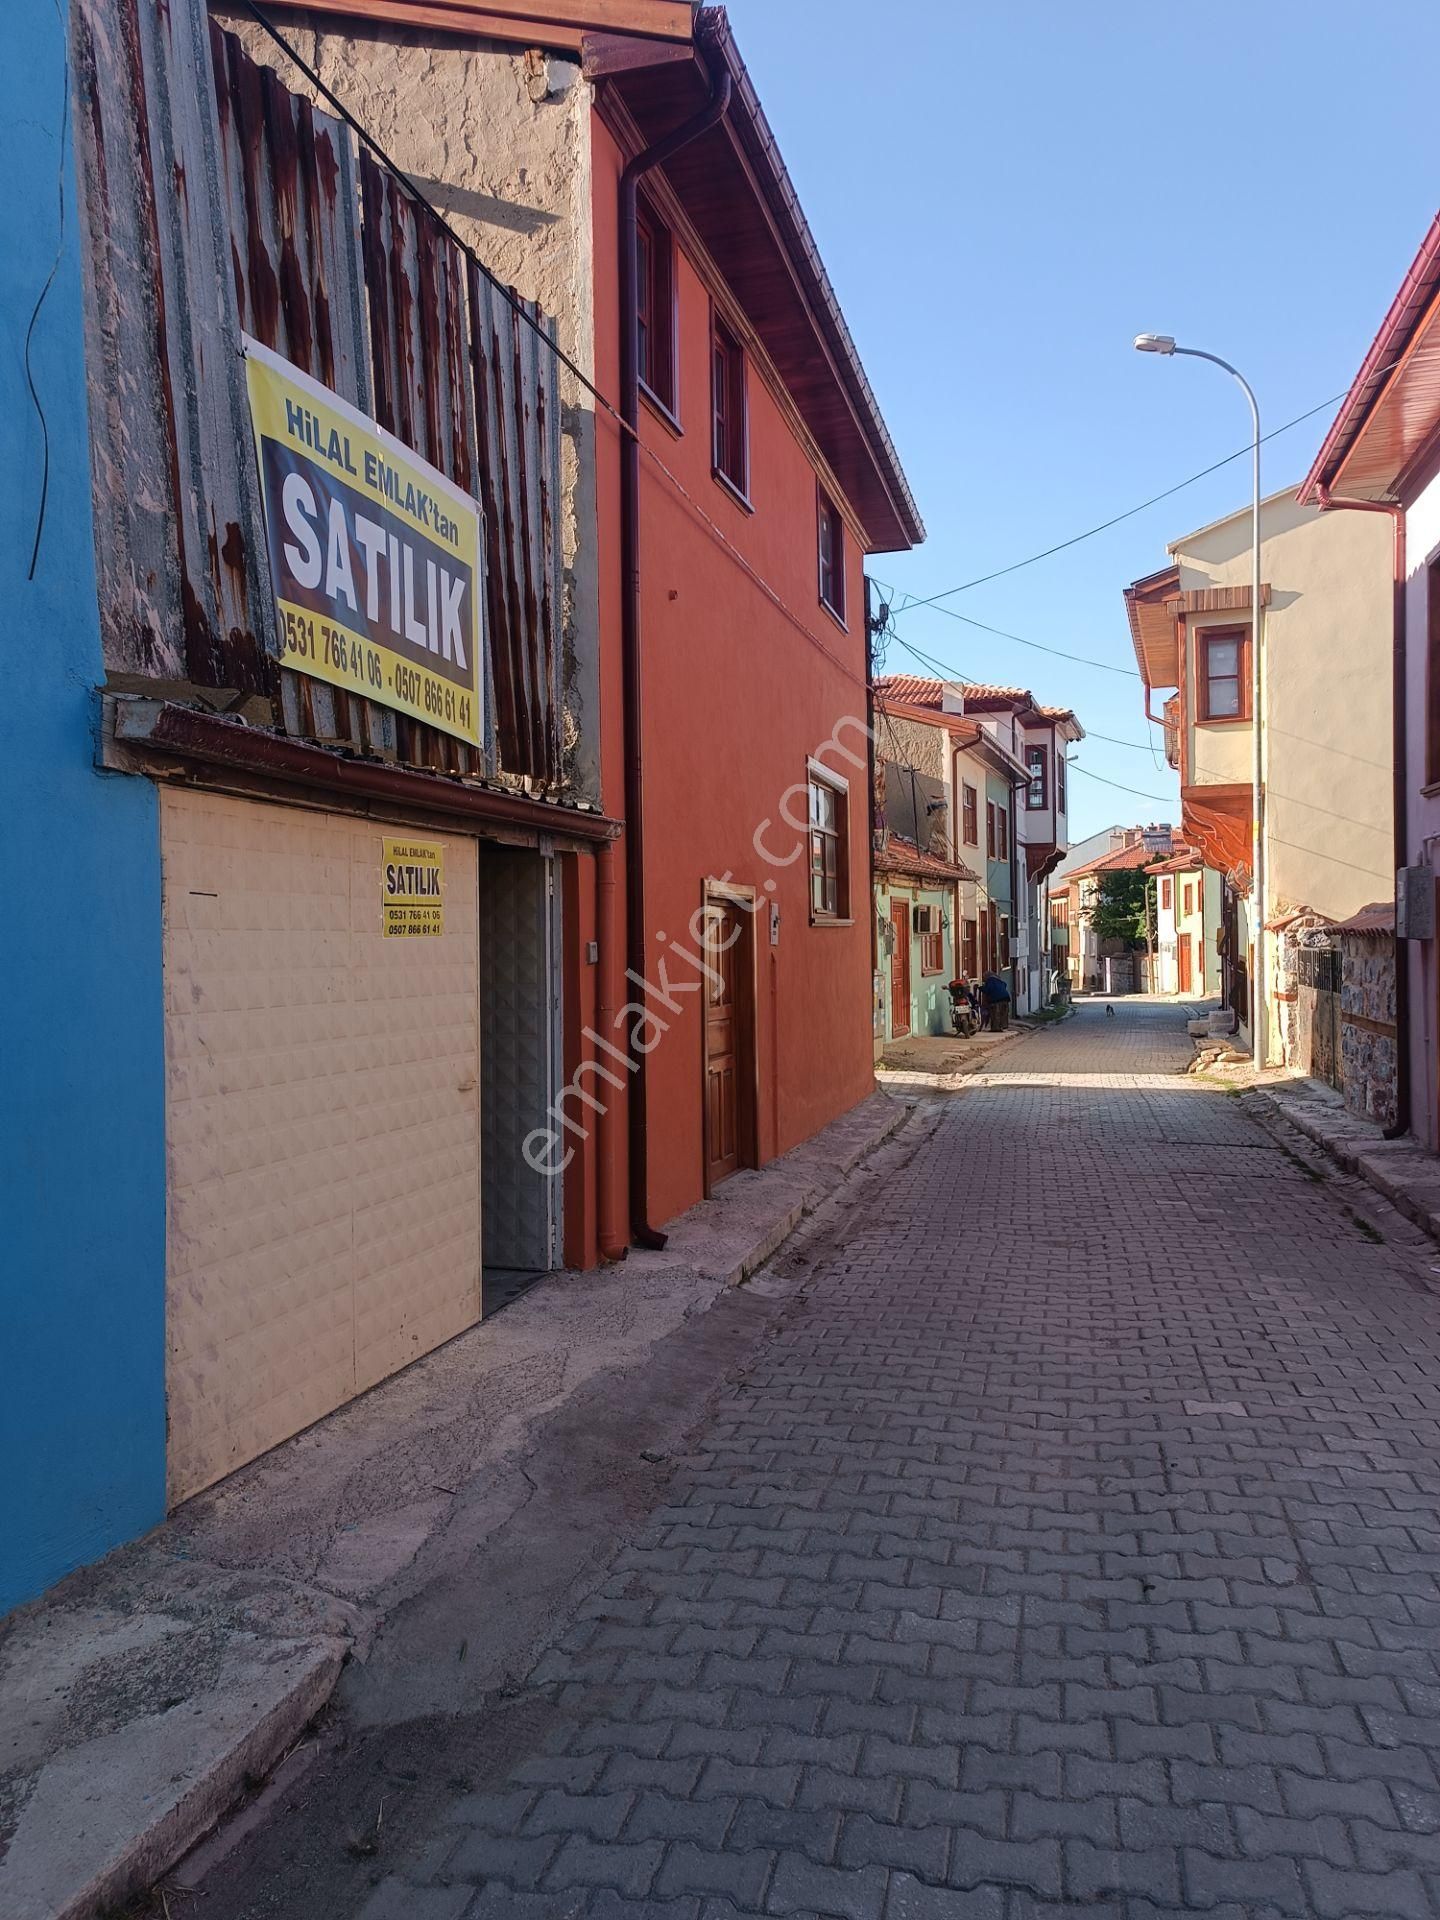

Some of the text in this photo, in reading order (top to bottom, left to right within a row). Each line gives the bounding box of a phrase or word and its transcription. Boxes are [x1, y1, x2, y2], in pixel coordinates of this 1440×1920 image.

[285, 398, 357, 476] HiLAL
[282, 472, 468, 671] SATILIK
[321, 625, 348, 673] 766
[350, 641, 364, 681] 41
[367, 649, 383, 690] 06
[395, 663, 421, 707] 0507
[424, 678, 442, 717] 866
[445, 688, 456, 723] 61
[459, 696, 471, 730] 41
[386, 864, 440, 896] SATILIK
[389, 910, 406, 920] 0531
[409, 910, 421, 920] 766
[423, 911, 430, 920] 41
[389, 924, 440, 934] 0507 866 61 41
